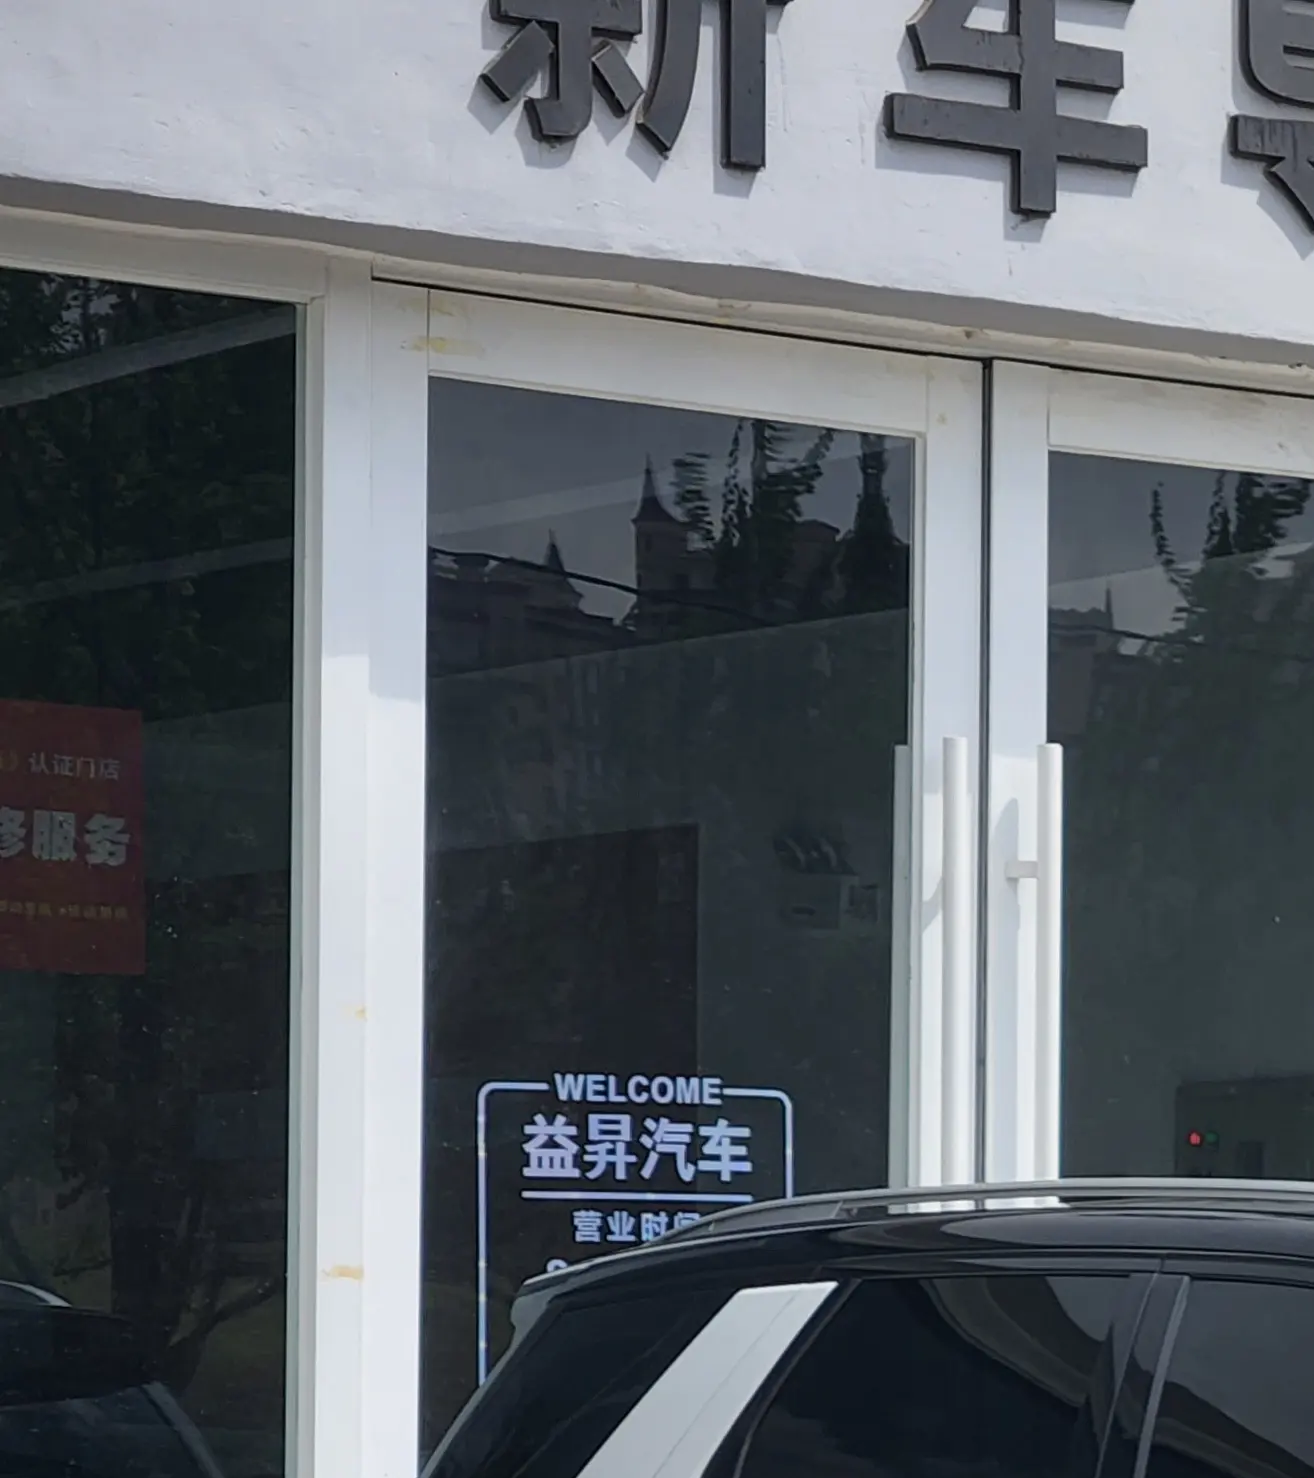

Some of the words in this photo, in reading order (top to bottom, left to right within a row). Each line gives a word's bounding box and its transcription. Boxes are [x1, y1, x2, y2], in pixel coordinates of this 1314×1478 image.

[29, 752, 120, 780] 认证门店
[554, 1073, 722, 1104] WELCOME
[522, 1113, 752, 1182] 益昇汽车
